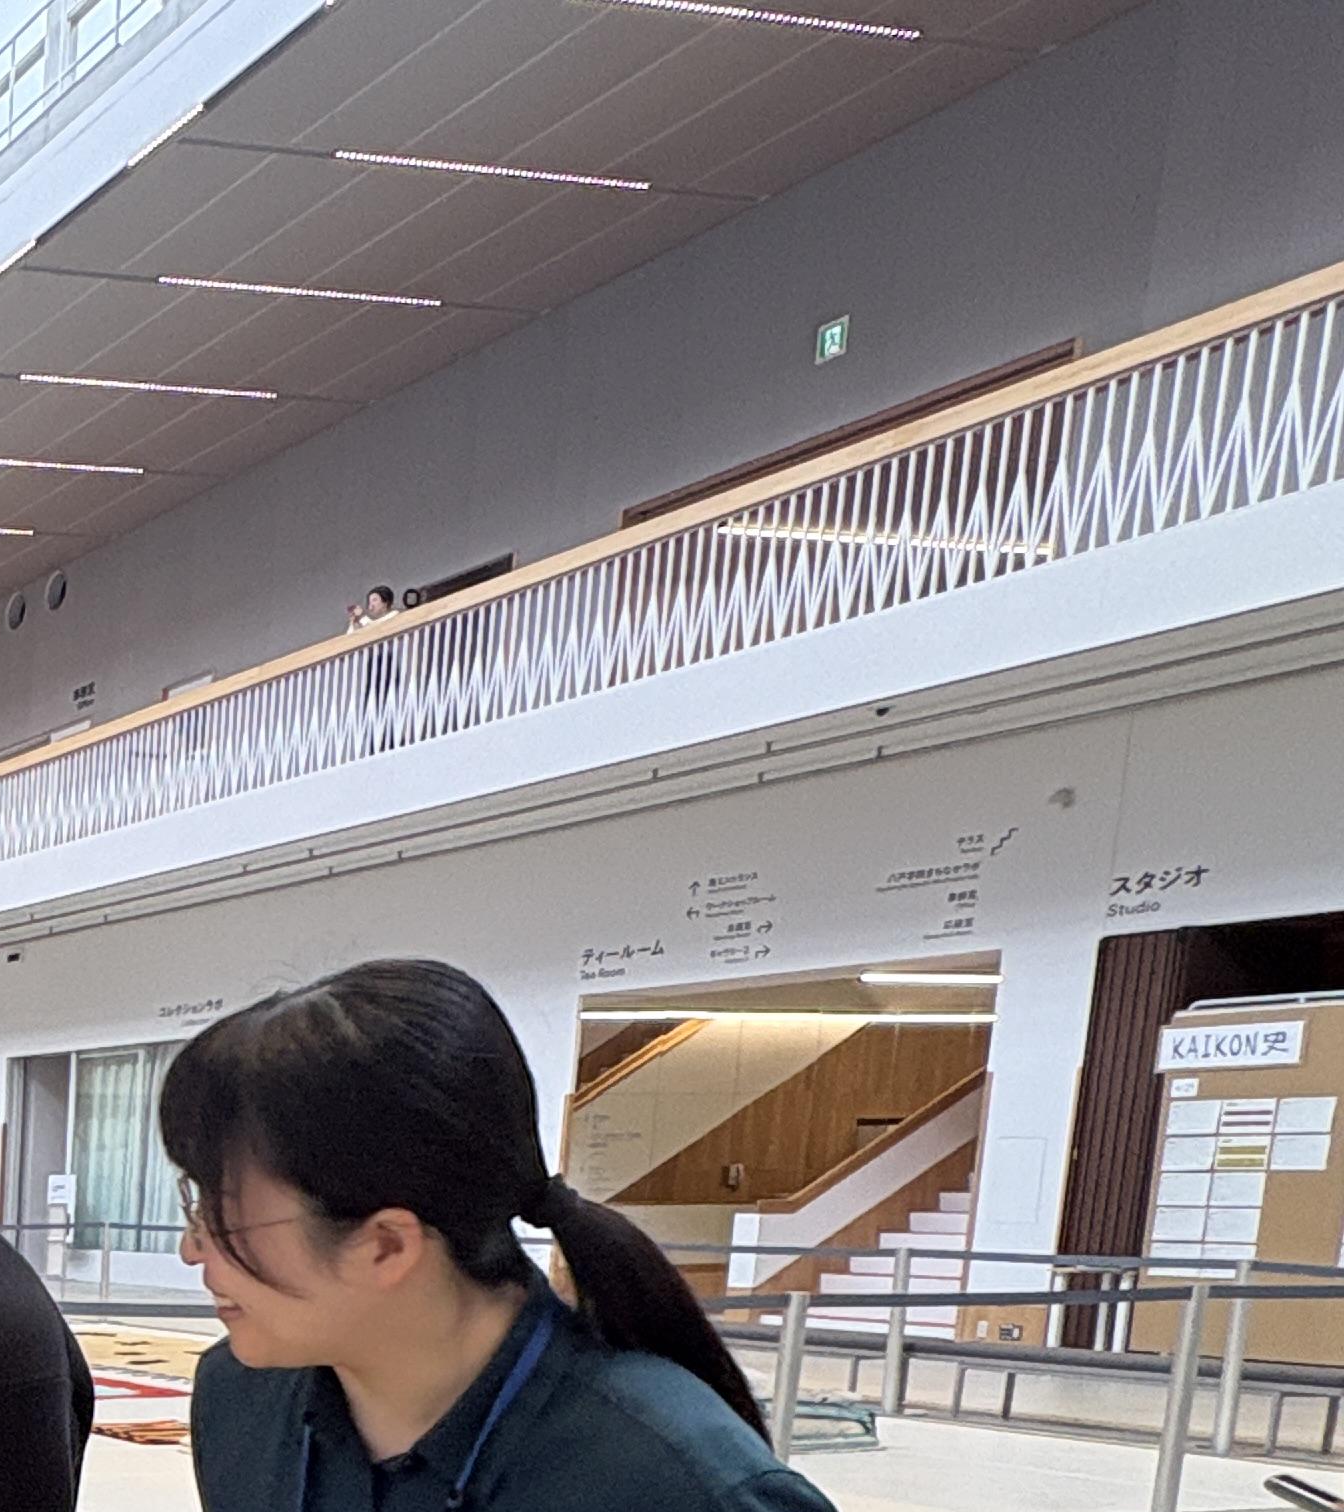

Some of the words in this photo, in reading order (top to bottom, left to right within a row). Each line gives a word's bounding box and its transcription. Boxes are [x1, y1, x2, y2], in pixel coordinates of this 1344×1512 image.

[1109, 865, 1210, 896] スタジオ
[1106, 901, 1161, 918] Studio
[581, 939, 665, 966] ティールーム
[1171, 1031, 1290, 1060] KAIKON史
